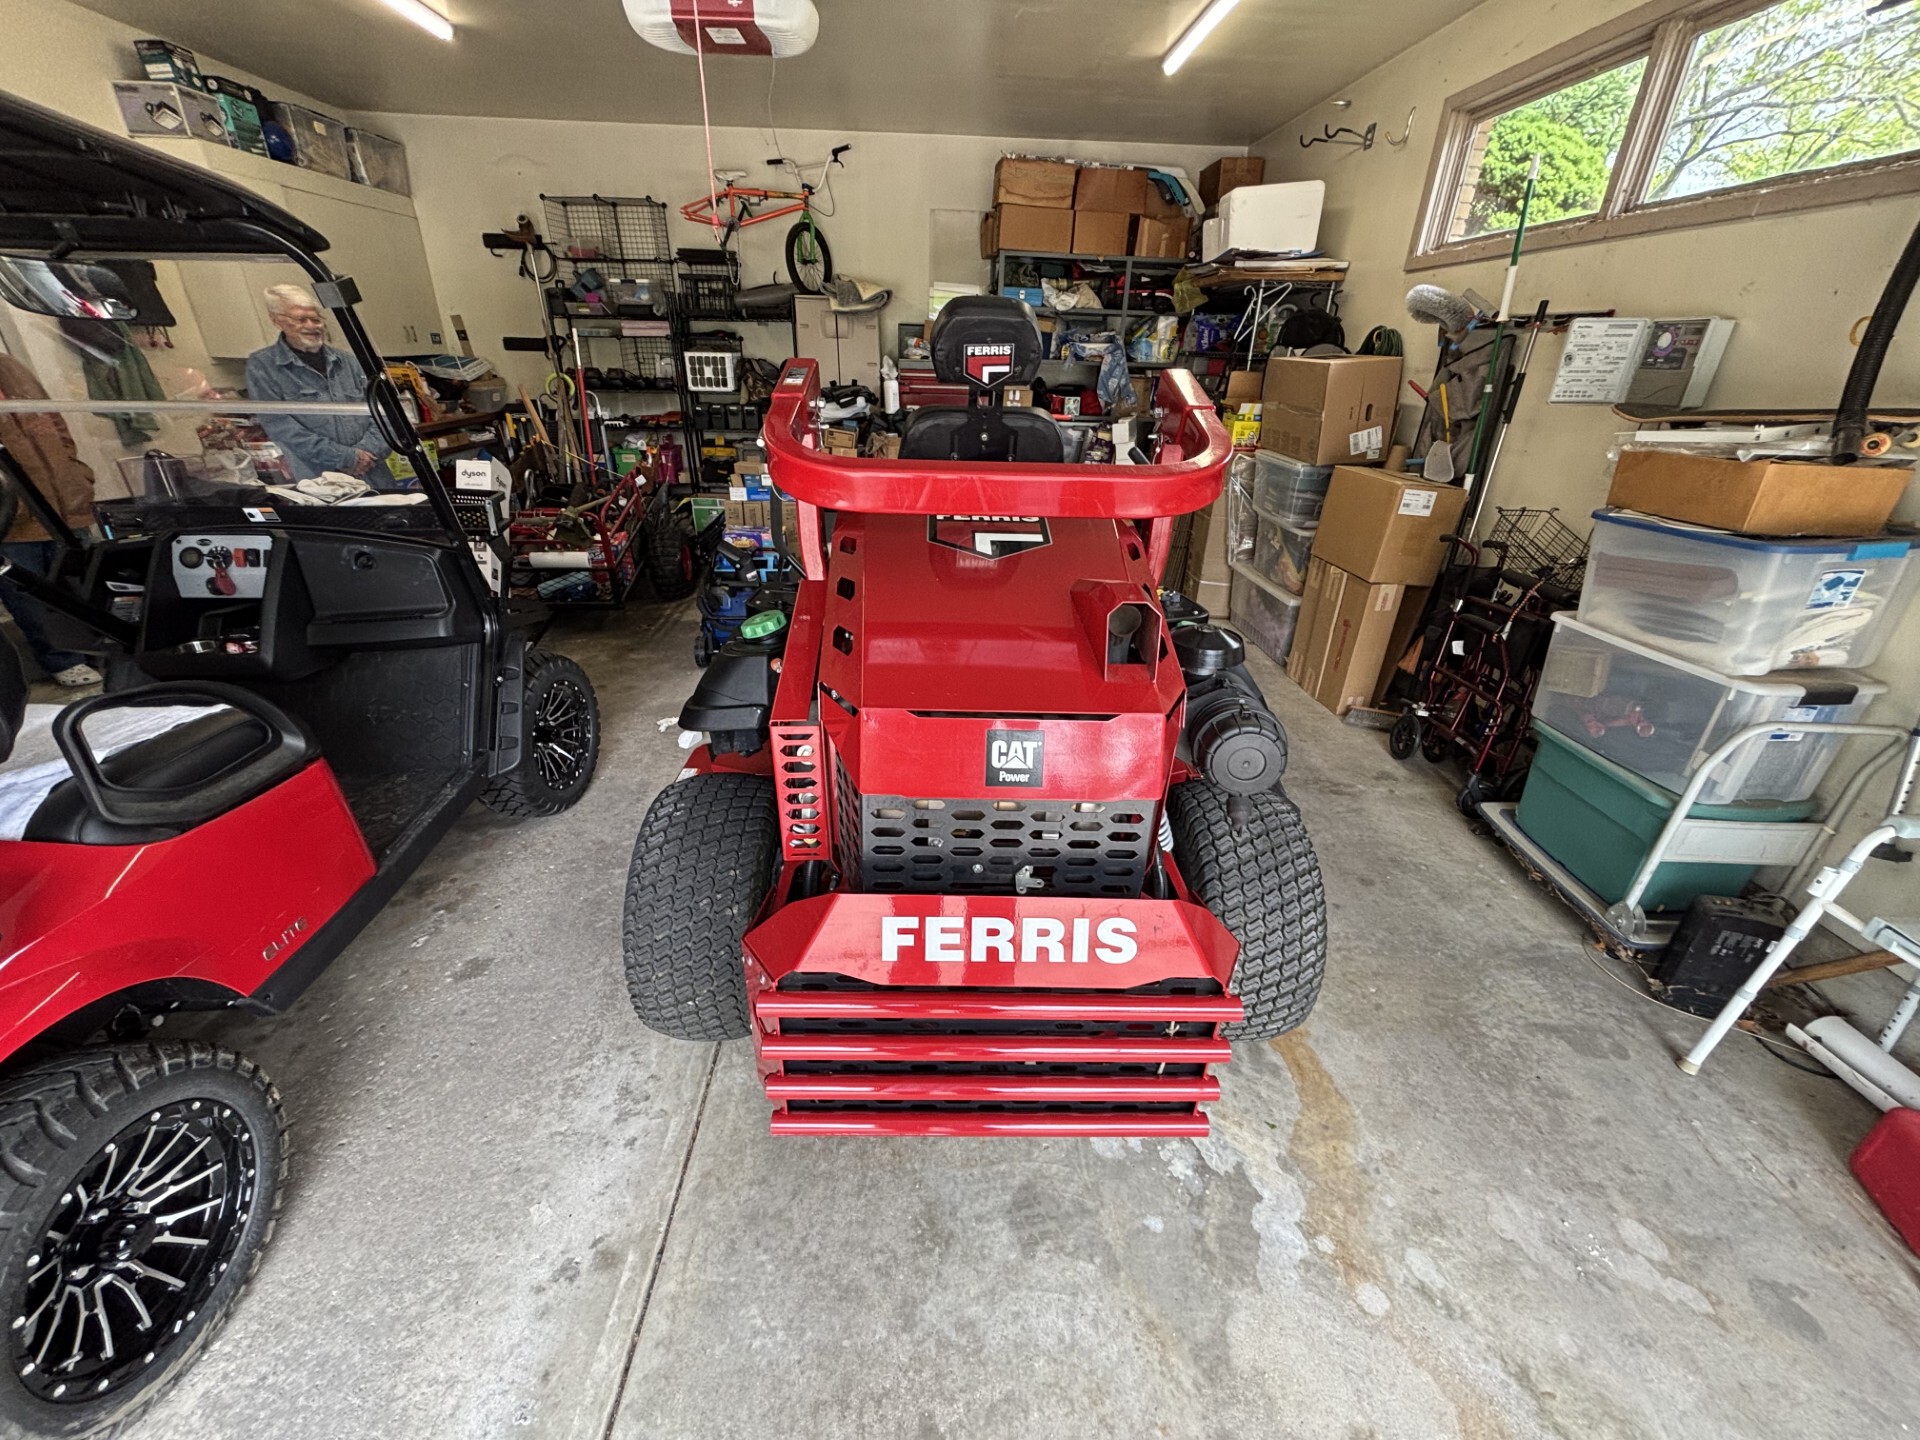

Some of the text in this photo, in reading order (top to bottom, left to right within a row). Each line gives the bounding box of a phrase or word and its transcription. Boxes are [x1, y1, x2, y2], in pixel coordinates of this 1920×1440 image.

[967, 346, 1011, 355] FERRIS
[461, 469, 487, 478] dyson
[991, 740, 1037, 769] CAT
[999, 771, 1030, 782] Power
[881, 917, 1138, 964] FERRIS
